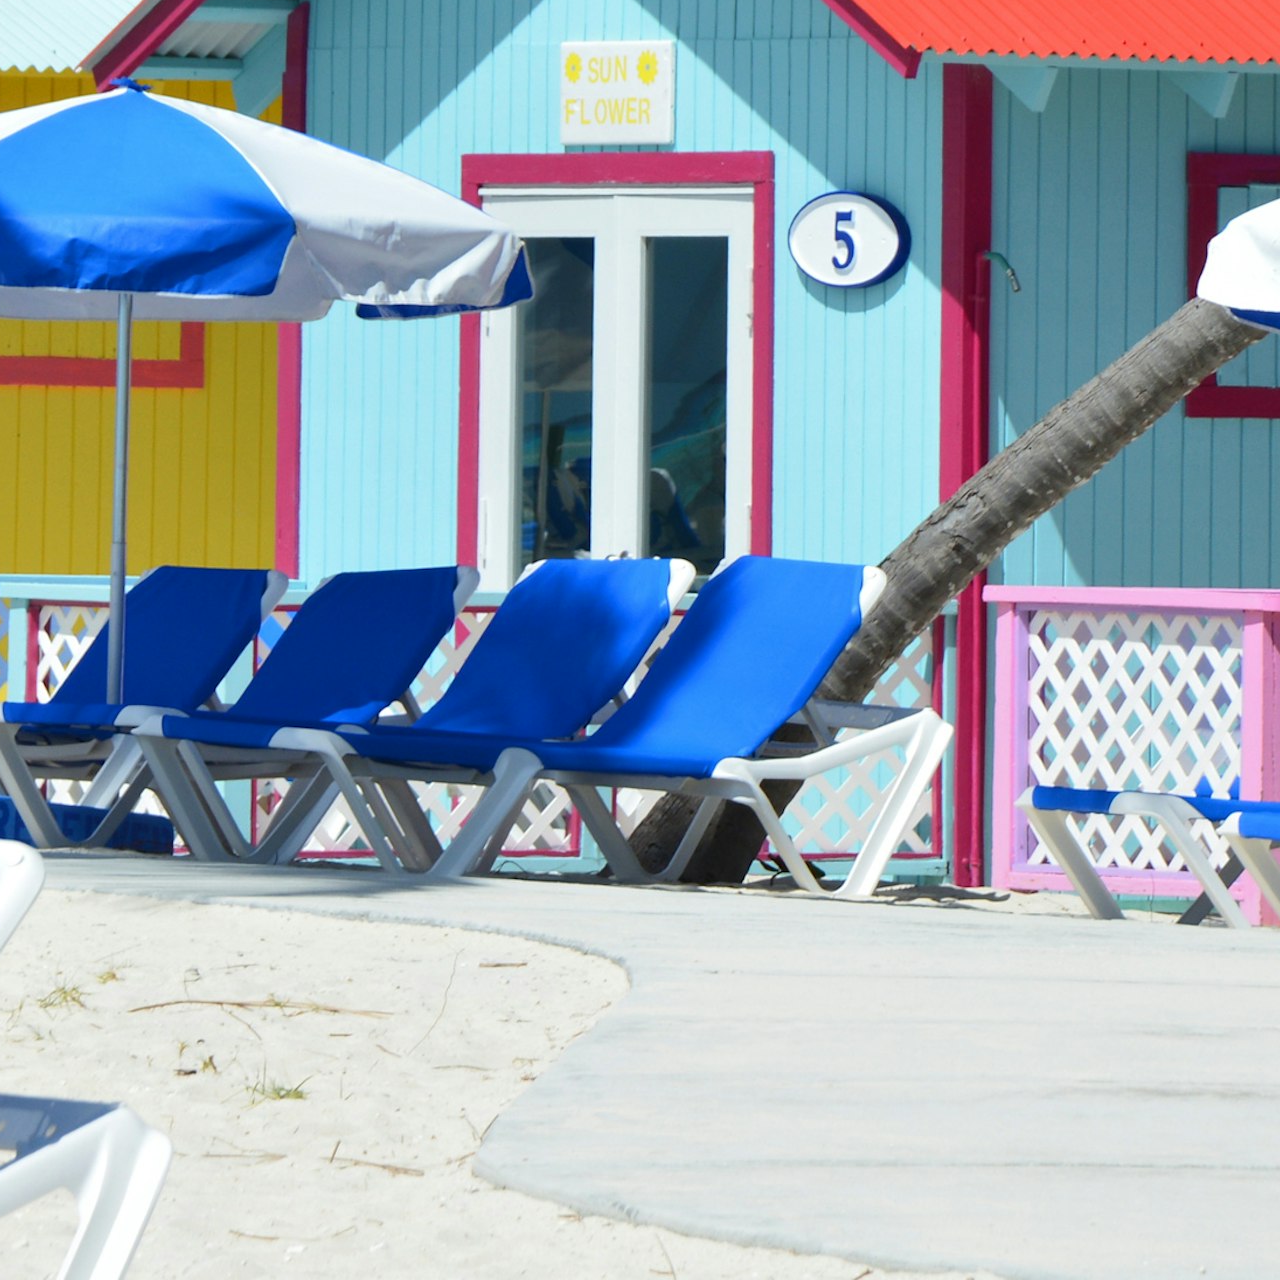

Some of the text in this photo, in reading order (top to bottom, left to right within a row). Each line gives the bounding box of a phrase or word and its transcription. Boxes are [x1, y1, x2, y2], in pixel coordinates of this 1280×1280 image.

[588, 55, 627, 83] SUN
[565, 97, 651, 125] FLOWER
[832, 210, 855, 269] 5
